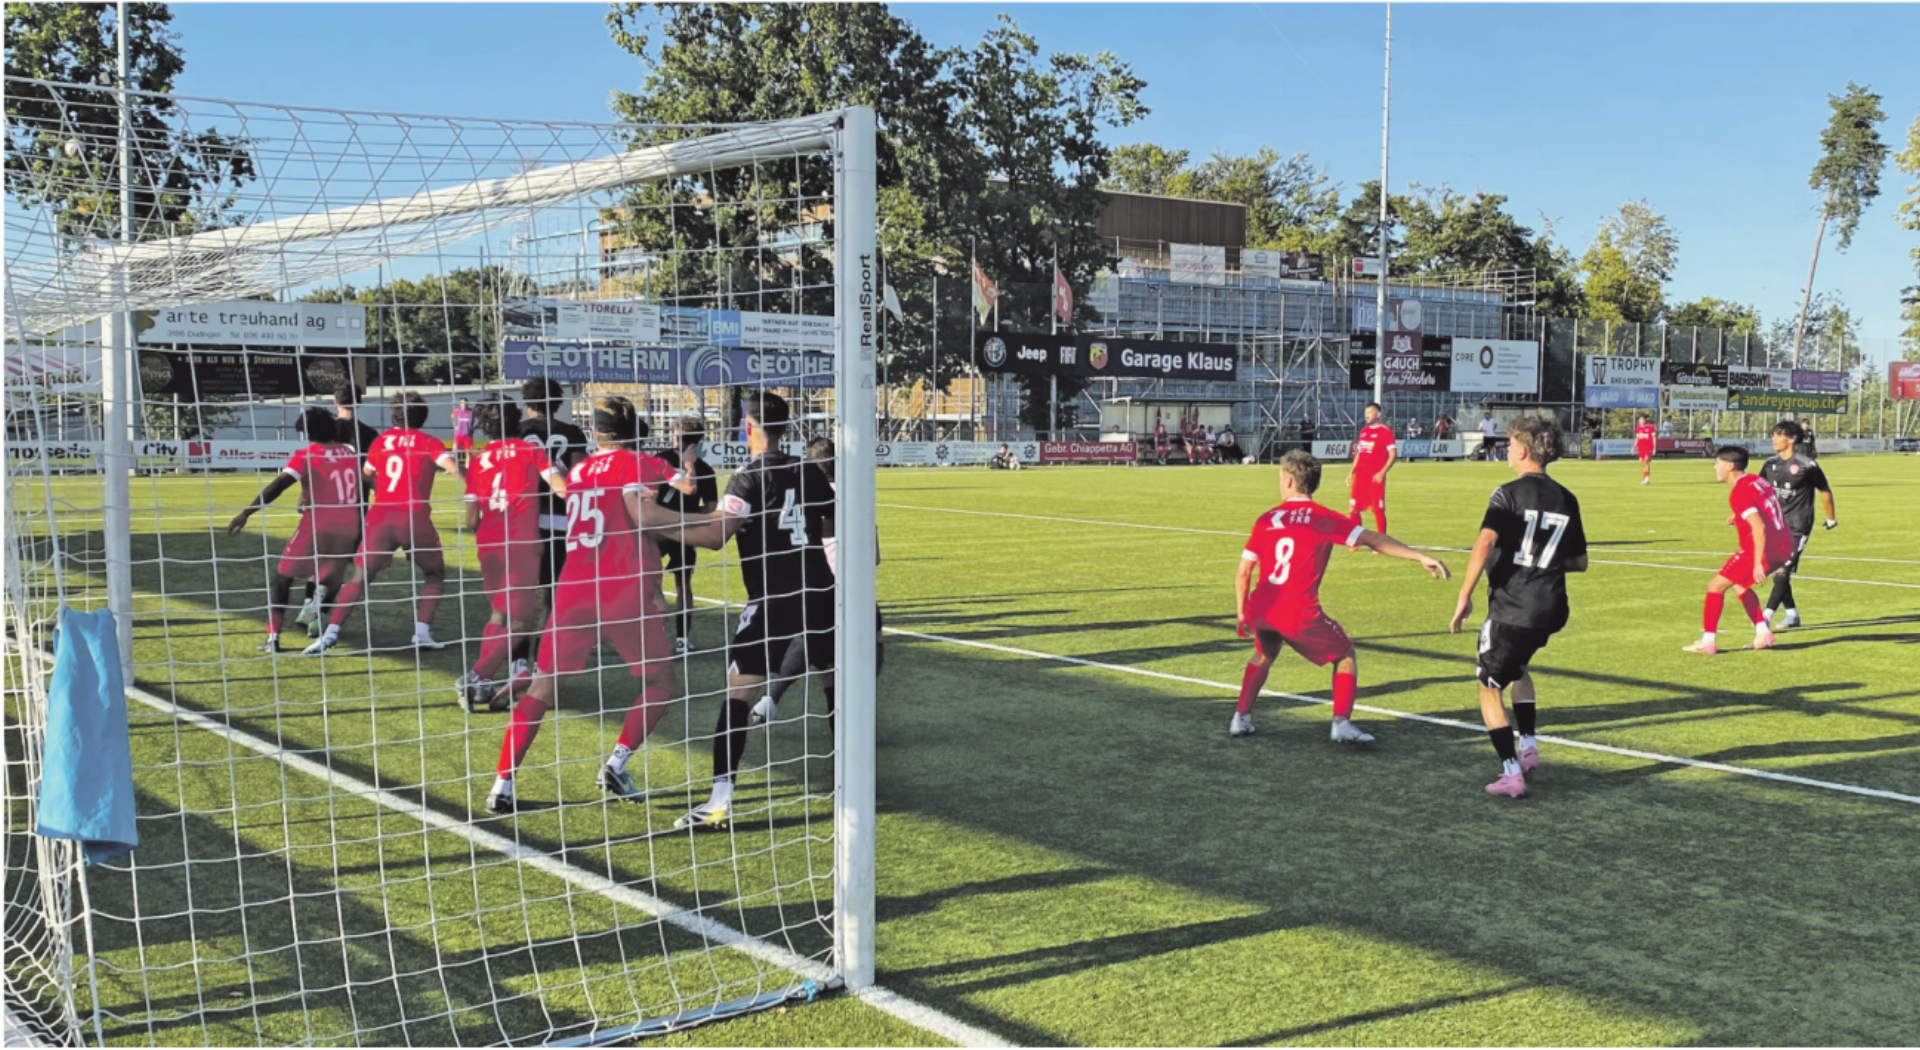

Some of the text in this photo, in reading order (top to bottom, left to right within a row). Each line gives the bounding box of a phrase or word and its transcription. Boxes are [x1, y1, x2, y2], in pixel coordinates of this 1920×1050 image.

[860, 254, 873, 346] RealSport
[218, 311, 298, 326] treuhand
[306, 316, 325, 331] ag
[713, 320, 739, 336] BMI
[526, 344, 670, 371] GEOTHERM
[1017, 345, 1047, 362] Jeep
[1121, 348, 1233, 373] Garage Klaus
[1384, 357, 1420, 370] GAUCH
[1455, 352, 1474, 363] CORE
[746, 354, 834, 375] GEOTHE
[1611, 357, 1655, 372] TROPHY
[1742, 392, 1835, 411] andreygroup.ch
[1044, 442, 1133, 455] Gebr. Chiappetta AG
[1325, 444, 1347, 456] REGA
[1404, 442, 1449, 455] SENSE LAN
[386, 455, 403, 493] 9
[329, 468, 357, 505] 18
[489, 471, 509, 513] 4
[567, 488, 605, 553] 25
[778, 488, 809, 546] 4
[1513, 509, 1570, 569] 17
[1268, 536, 1295, 585] 8
